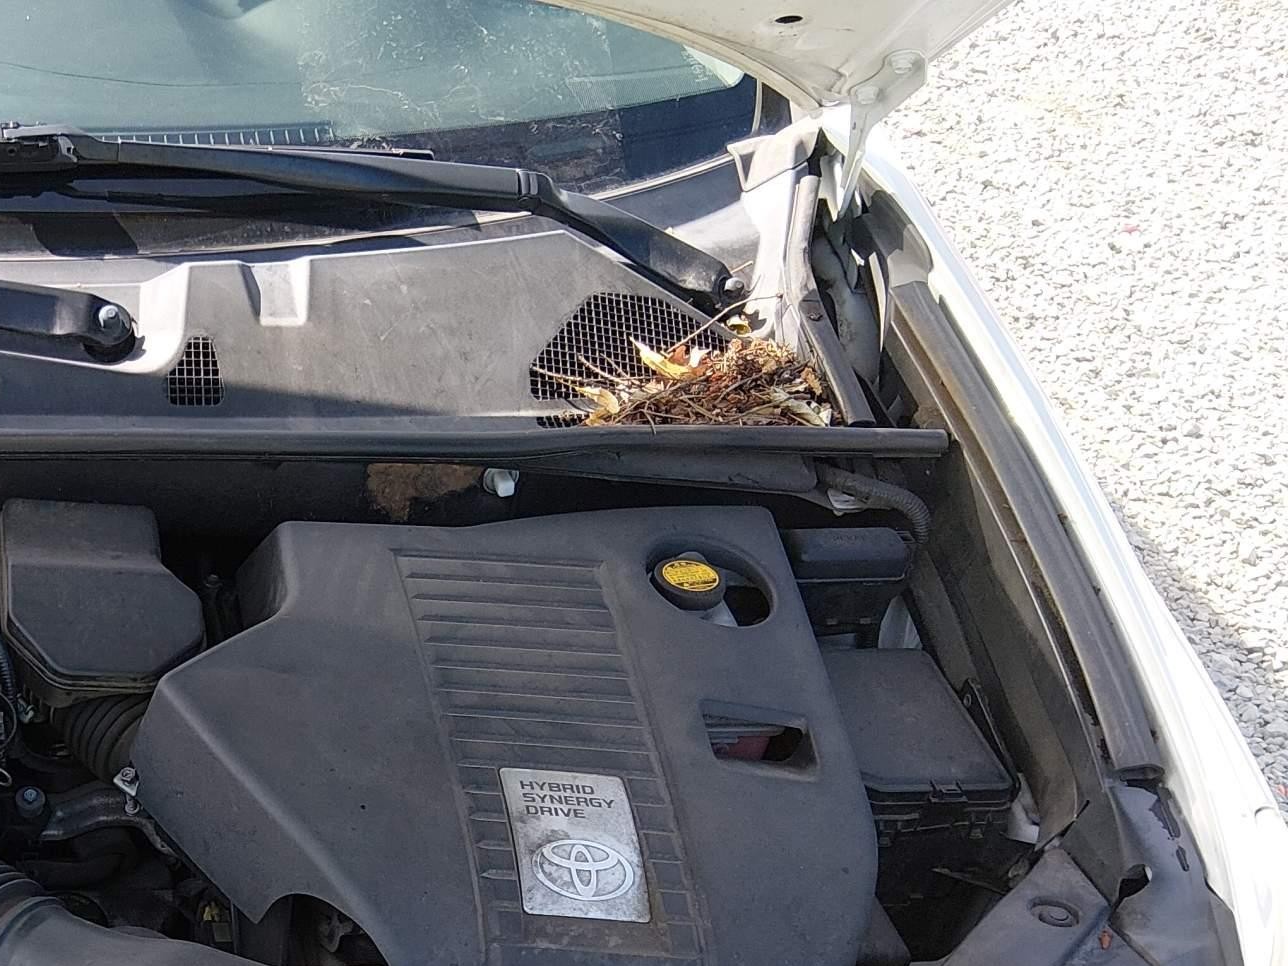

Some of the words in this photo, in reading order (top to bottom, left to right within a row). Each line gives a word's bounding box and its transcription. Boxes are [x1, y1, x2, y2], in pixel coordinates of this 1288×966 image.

[519, 780, 595, 795] HYBRID
[522, 793, 615, 809] SYNERGY
[526, 805, 586, 819] DRIVE
